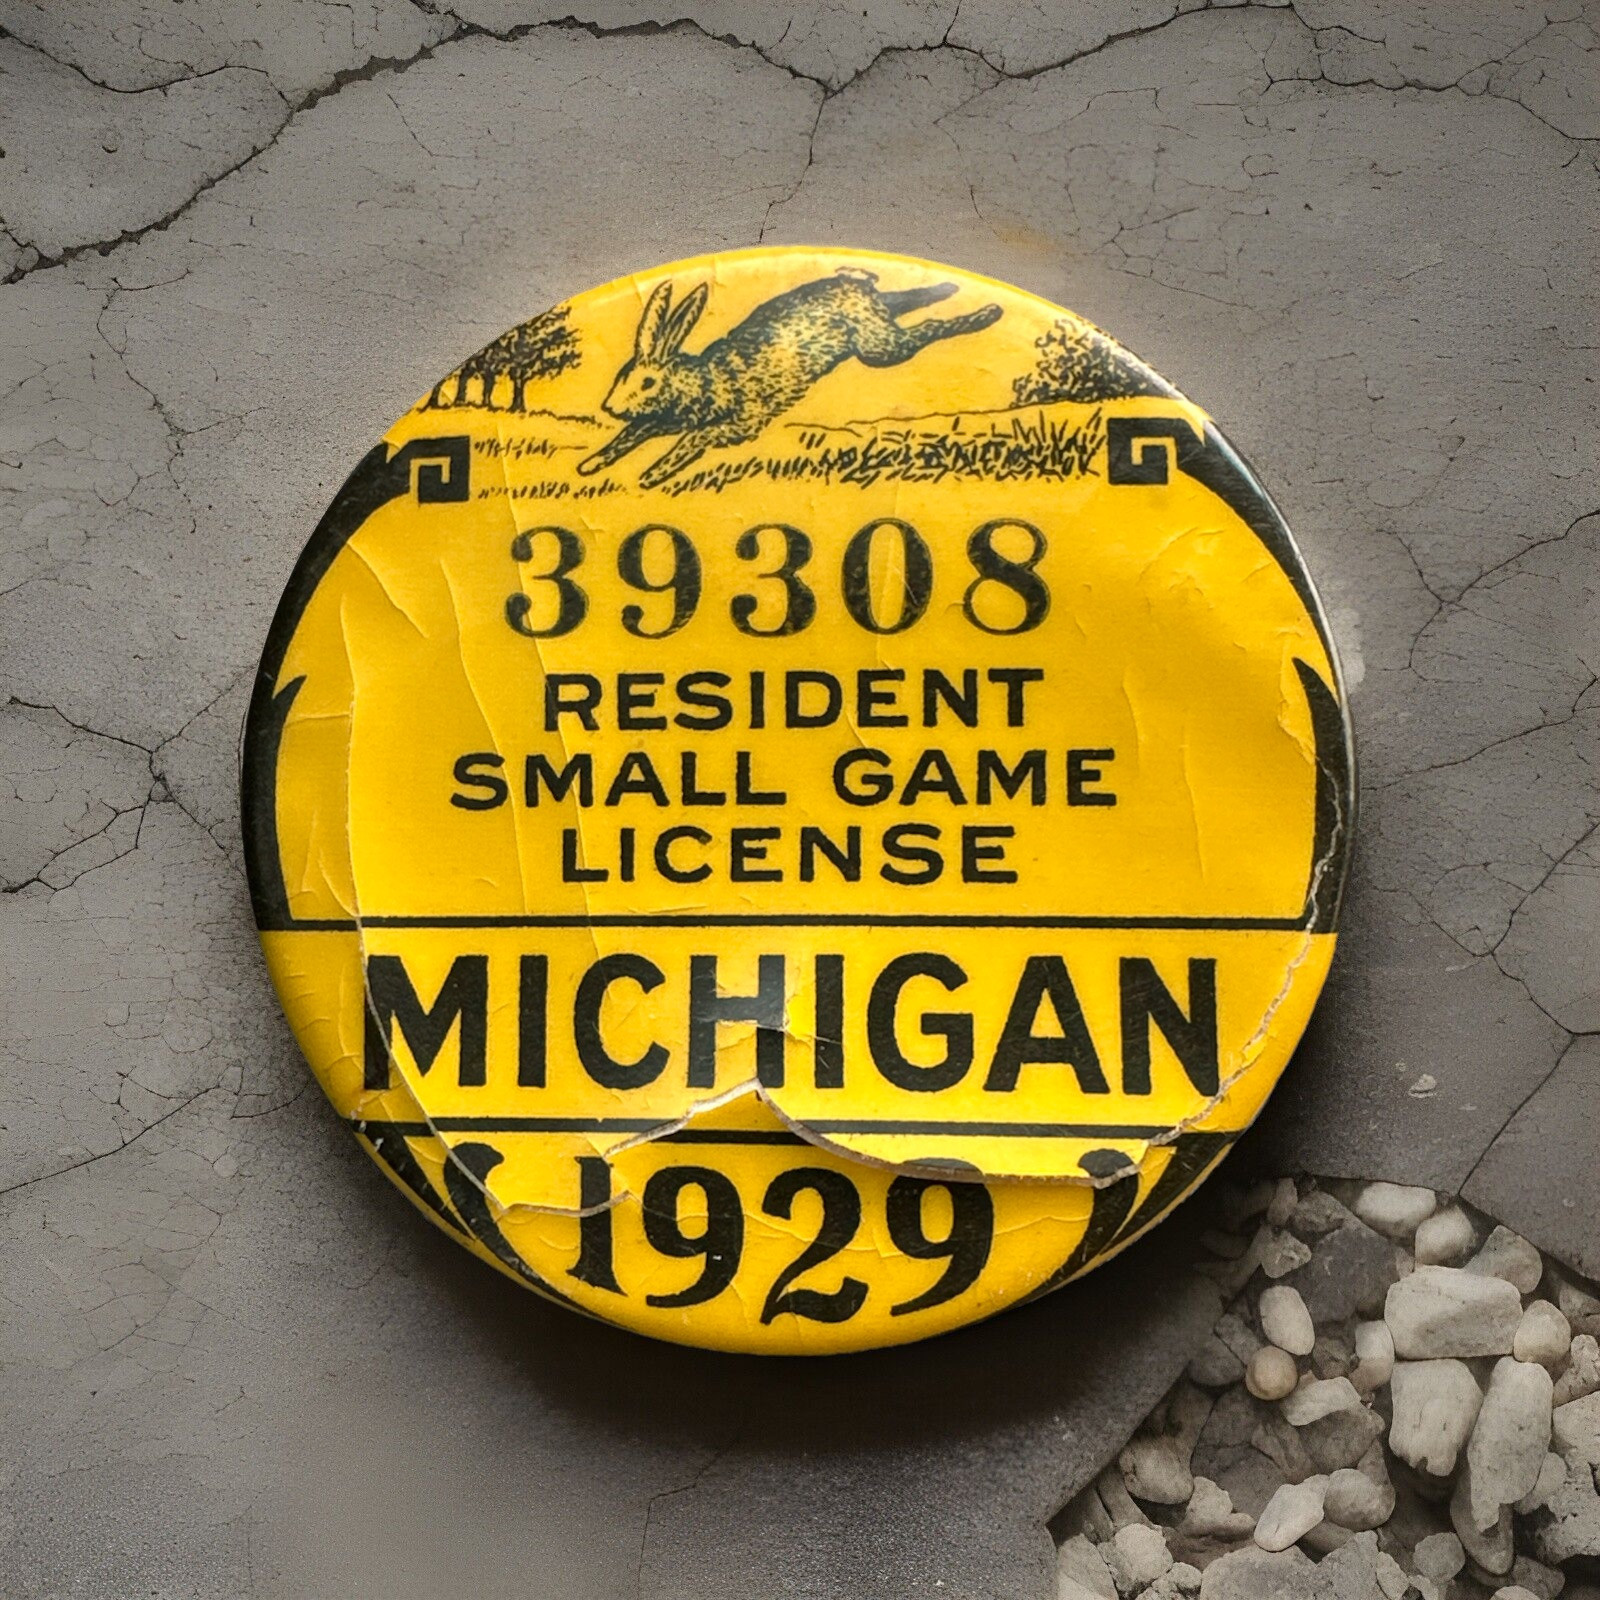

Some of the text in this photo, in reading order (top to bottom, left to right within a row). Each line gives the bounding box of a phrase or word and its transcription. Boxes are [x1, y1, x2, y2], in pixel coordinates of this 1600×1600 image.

[504, 517, 1051, 639] 39308
[543, 667, 1045, 732] RESIDENT
[450, 747, 1117, 811] SMALL GAME
[562, 822, 1018, 885] LICENSE
[362, 952, 1221, 1097] MICHIGAN
[566, 1157, 995, 1326] 1929
